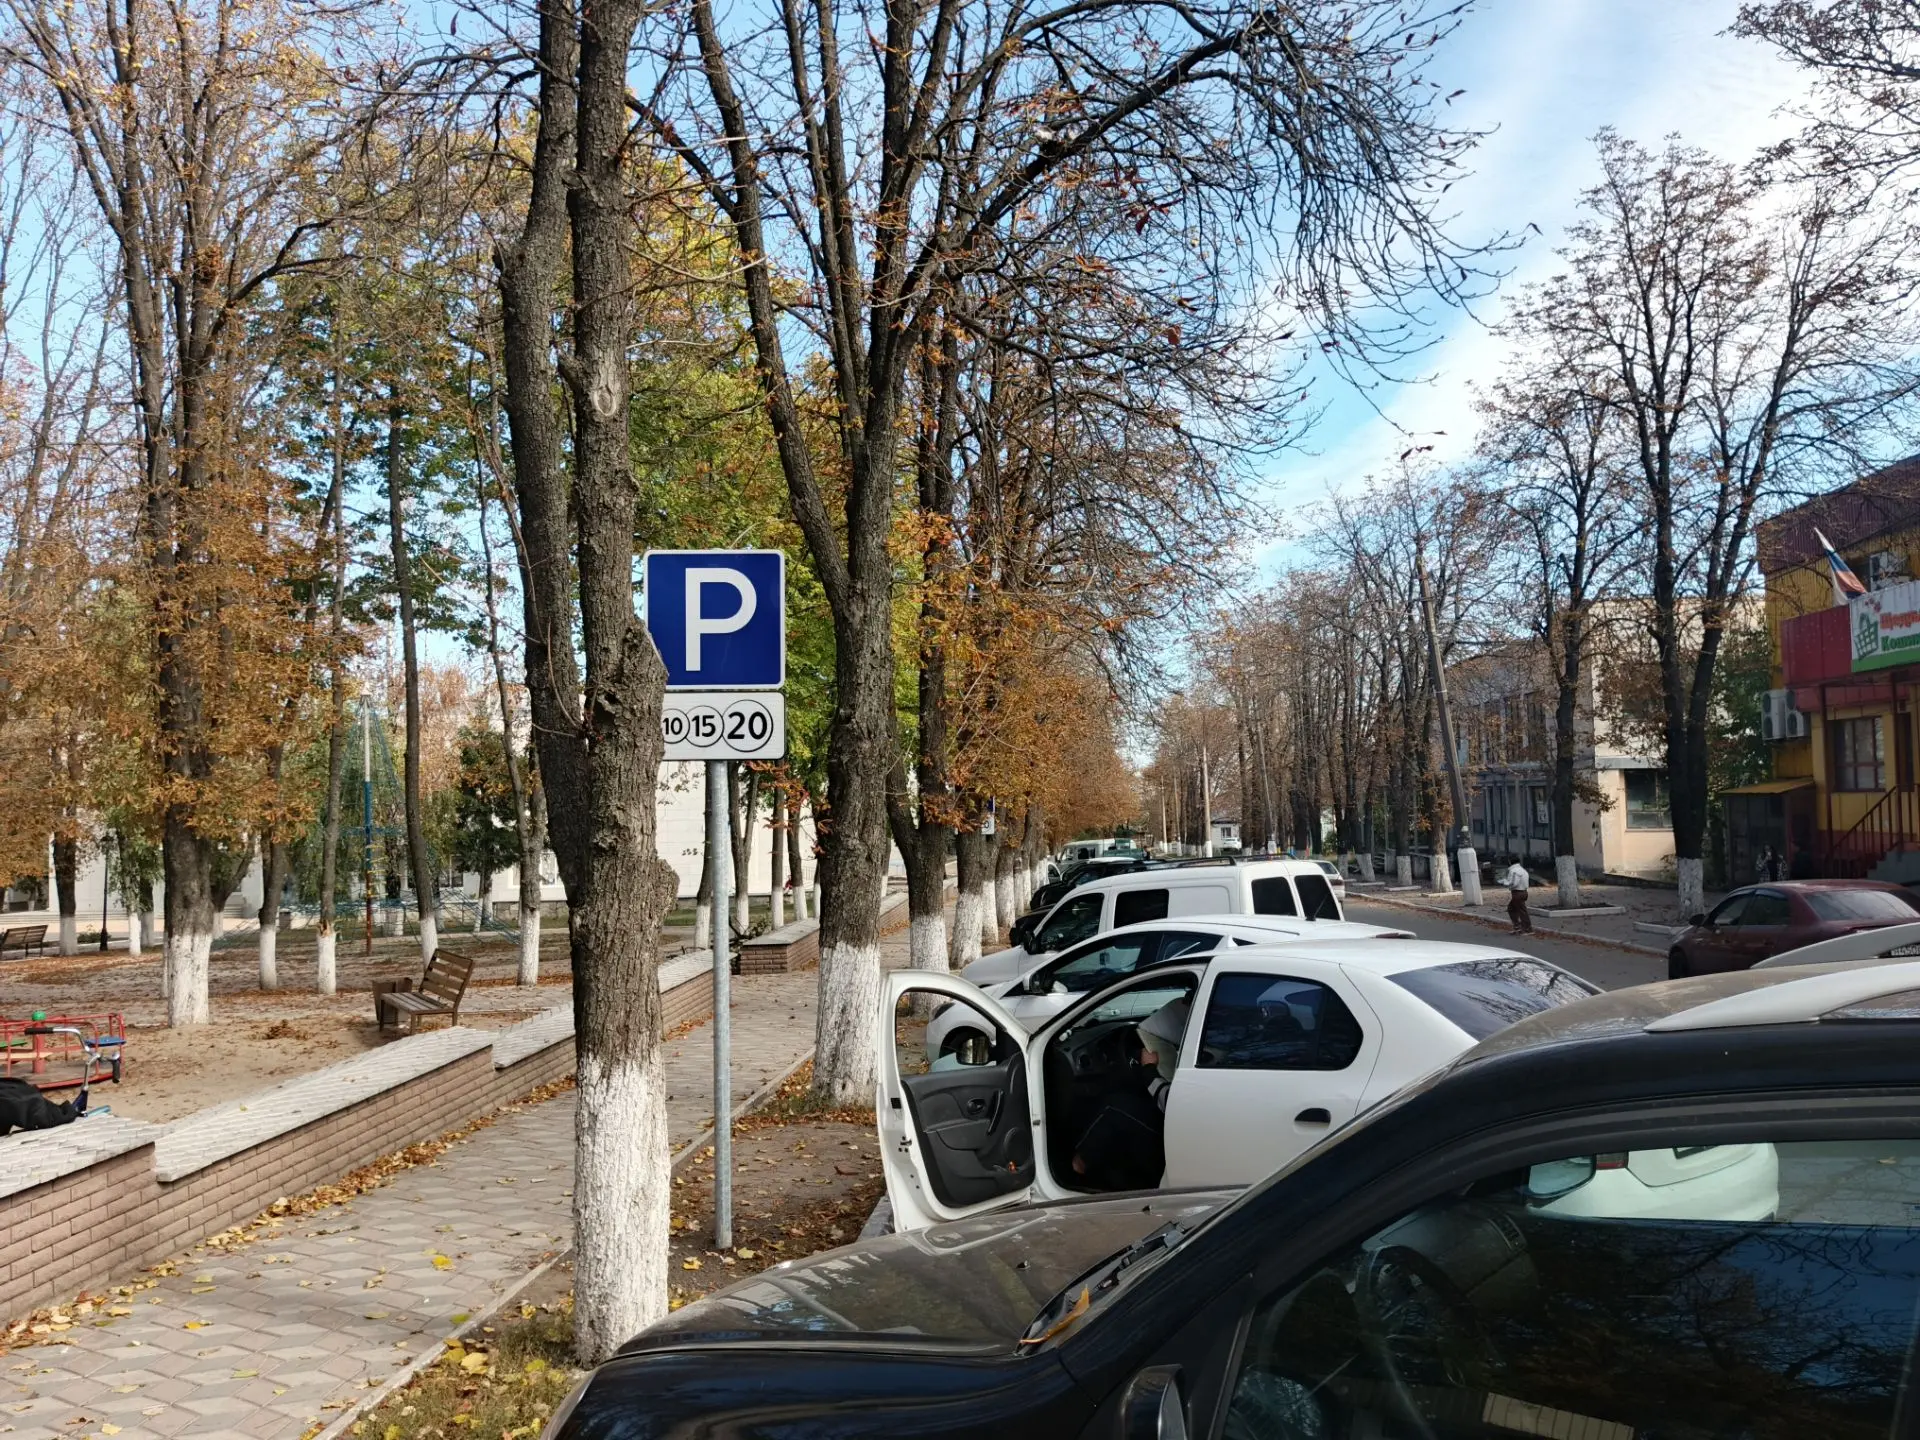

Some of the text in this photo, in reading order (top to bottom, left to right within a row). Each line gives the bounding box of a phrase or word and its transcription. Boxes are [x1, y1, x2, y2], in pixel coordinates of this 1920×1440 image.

[685, 567, 757, 671] P
[662, 711, 768, 740] 10 15 20
